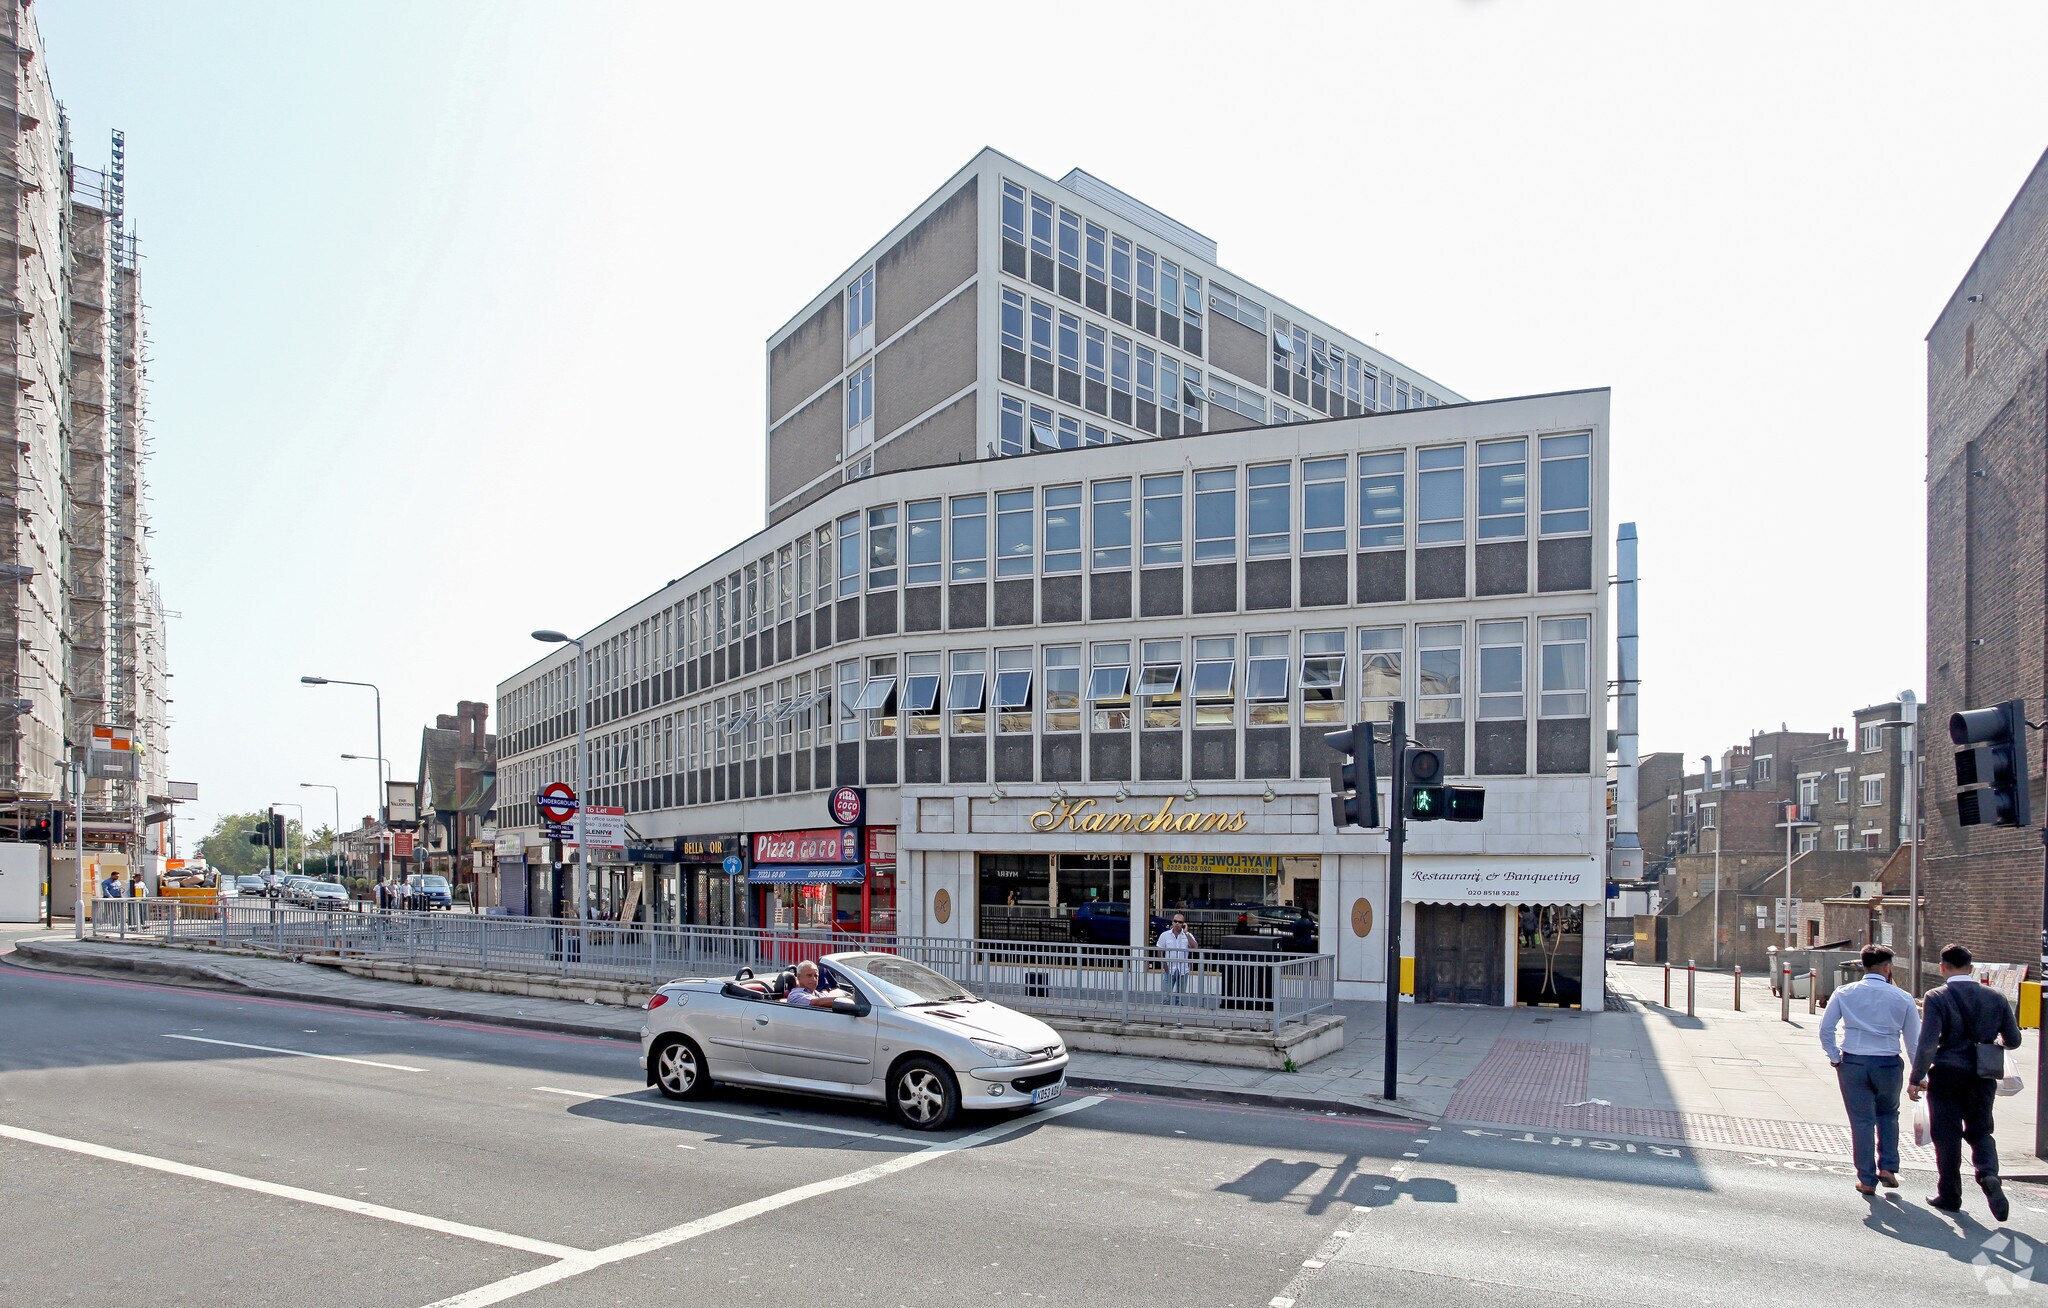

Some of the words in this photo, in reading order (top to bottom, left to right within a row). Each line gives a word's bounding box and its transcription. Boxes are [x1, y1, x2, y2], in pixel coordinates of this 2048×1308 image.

[537, 796, 580, 808] UNDERGROUND
[839, 791, 856, 801] PIZZA
[837, 801, 858, 810] GOGO
[1030, 797, 1248, 832] Kanchans
[684, 842, 704, 855] BELLA
[709, 841, 723, 854] OIR
[756, 836, 795, 861] Pizza
[800, 840, 837, 858] GOGO
[1411, 870, 1482, 882] Restaurant
[1486, 873, 1500, 881] &
[1503, 871, 1581, 884] Banqueting
[1510, 1133, 1681, 1159] RIGHT
